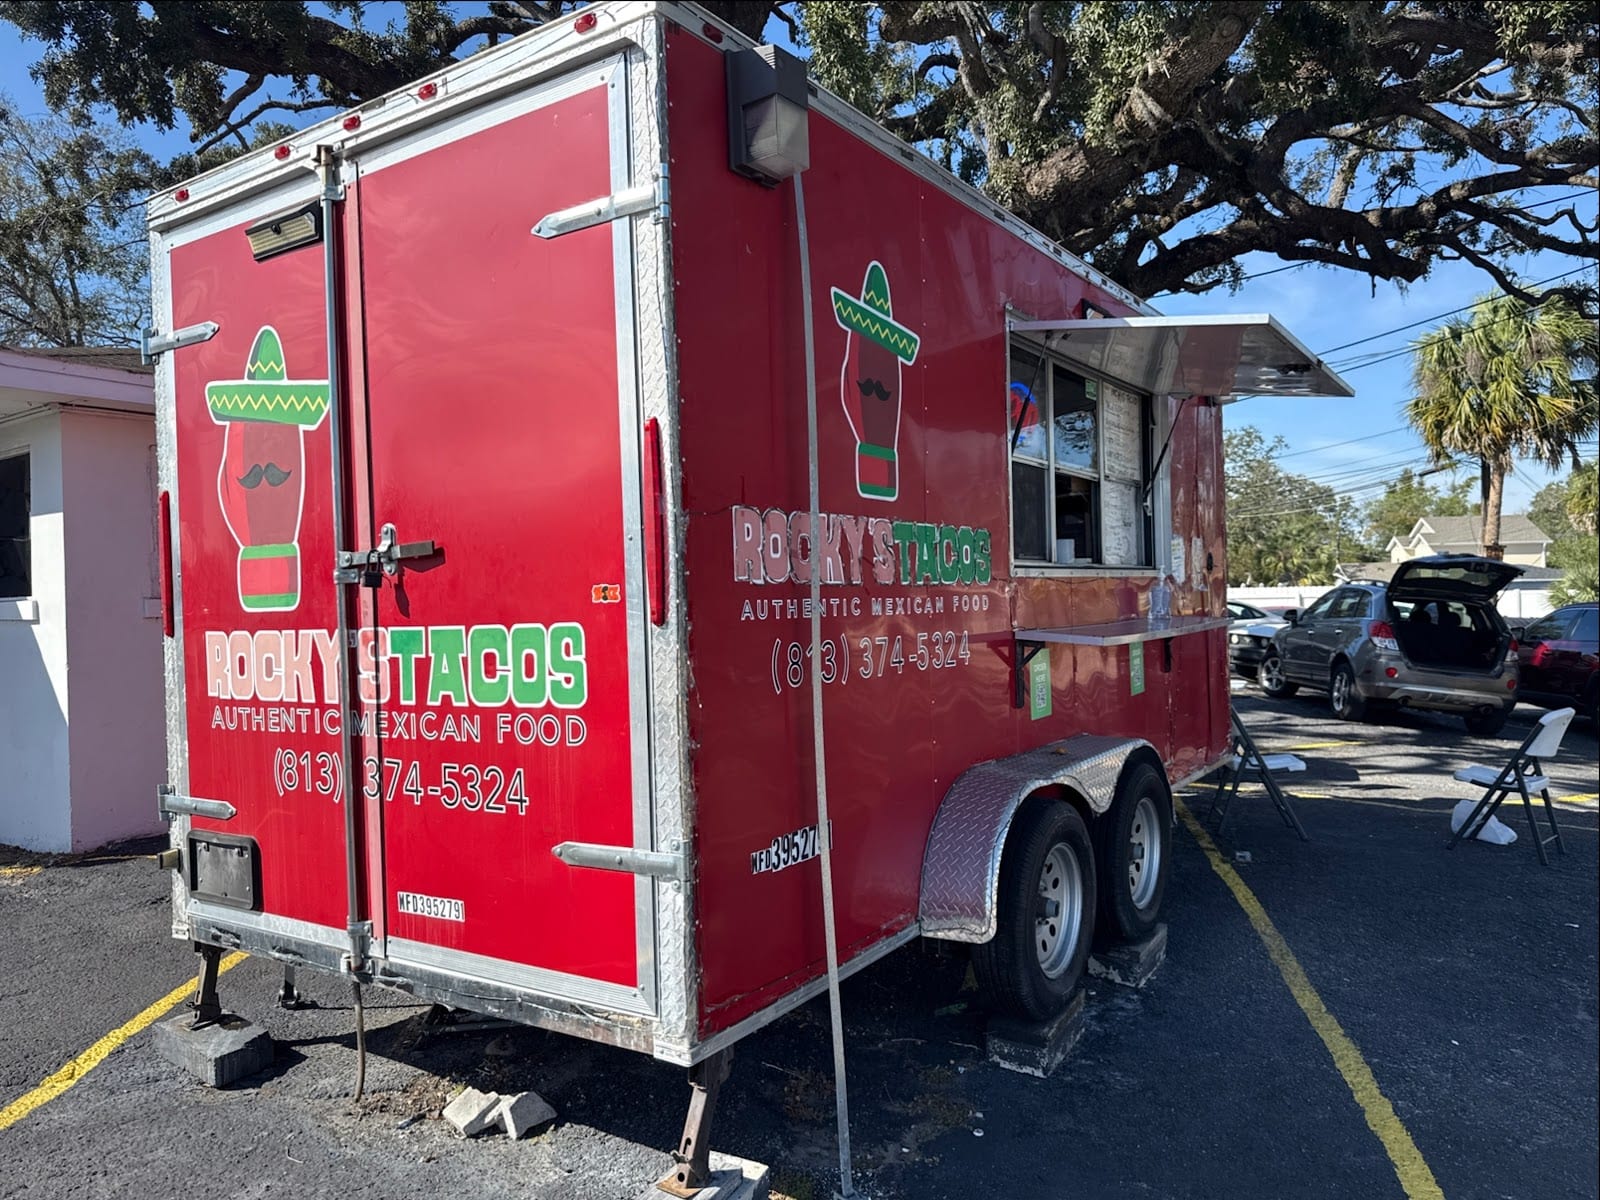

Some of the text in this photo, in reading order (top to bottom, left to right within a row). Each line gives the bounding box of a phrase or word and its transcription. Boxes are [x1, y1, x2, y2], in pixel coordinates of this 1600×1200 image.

[732, 505, 991, 585] ROCKY'S TACOS
[741, 594, 989, 621] AUTHENTIC MEXICAN FOOD
[205, 622, 587, 709] ROCKY'S TACOS
[772, 630, 971, 695] (83) 374-5324
[211, 705, 587, 747] AUTHENTIC MEXICAN FOOD
[274, 747, 529, 816] (813) 374-5324
